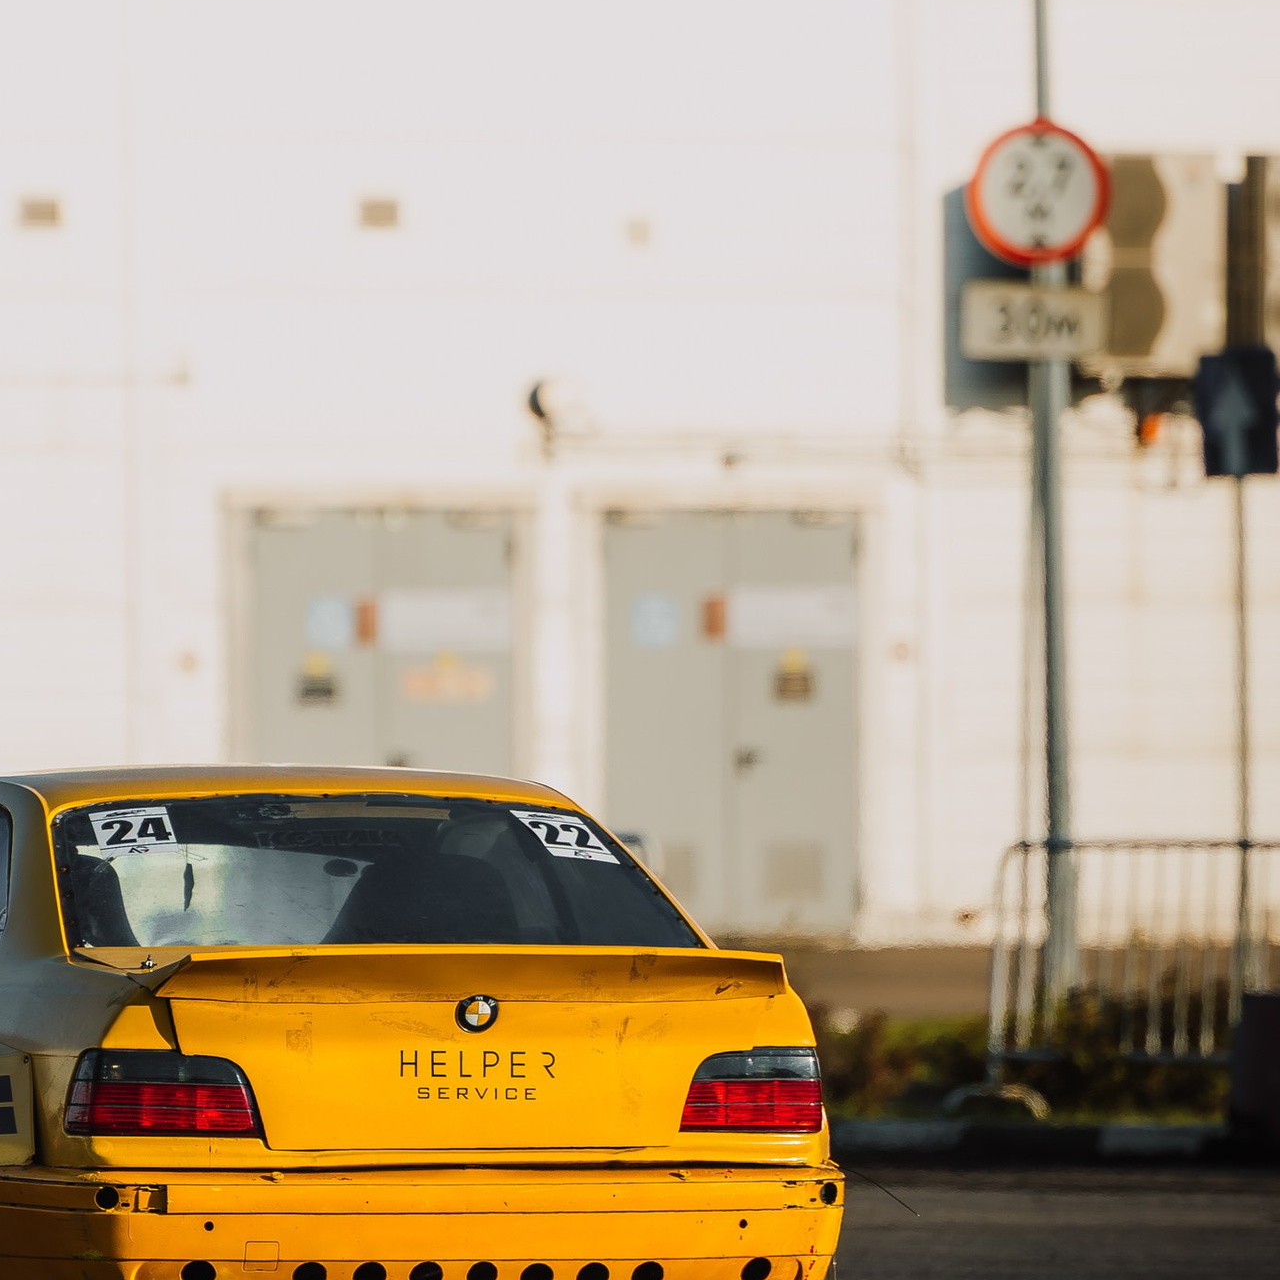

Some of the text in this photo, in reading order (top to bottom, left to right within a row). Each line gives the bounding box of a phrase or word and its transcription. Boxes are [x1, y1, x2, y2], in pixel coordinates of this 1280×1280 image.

[101, 816, 173, 846] 24
[528, 821, 604, 851] 22
[400, 1050, 556, 1079] HELPER
[417, 1087, 537, 1101] SERVICE
